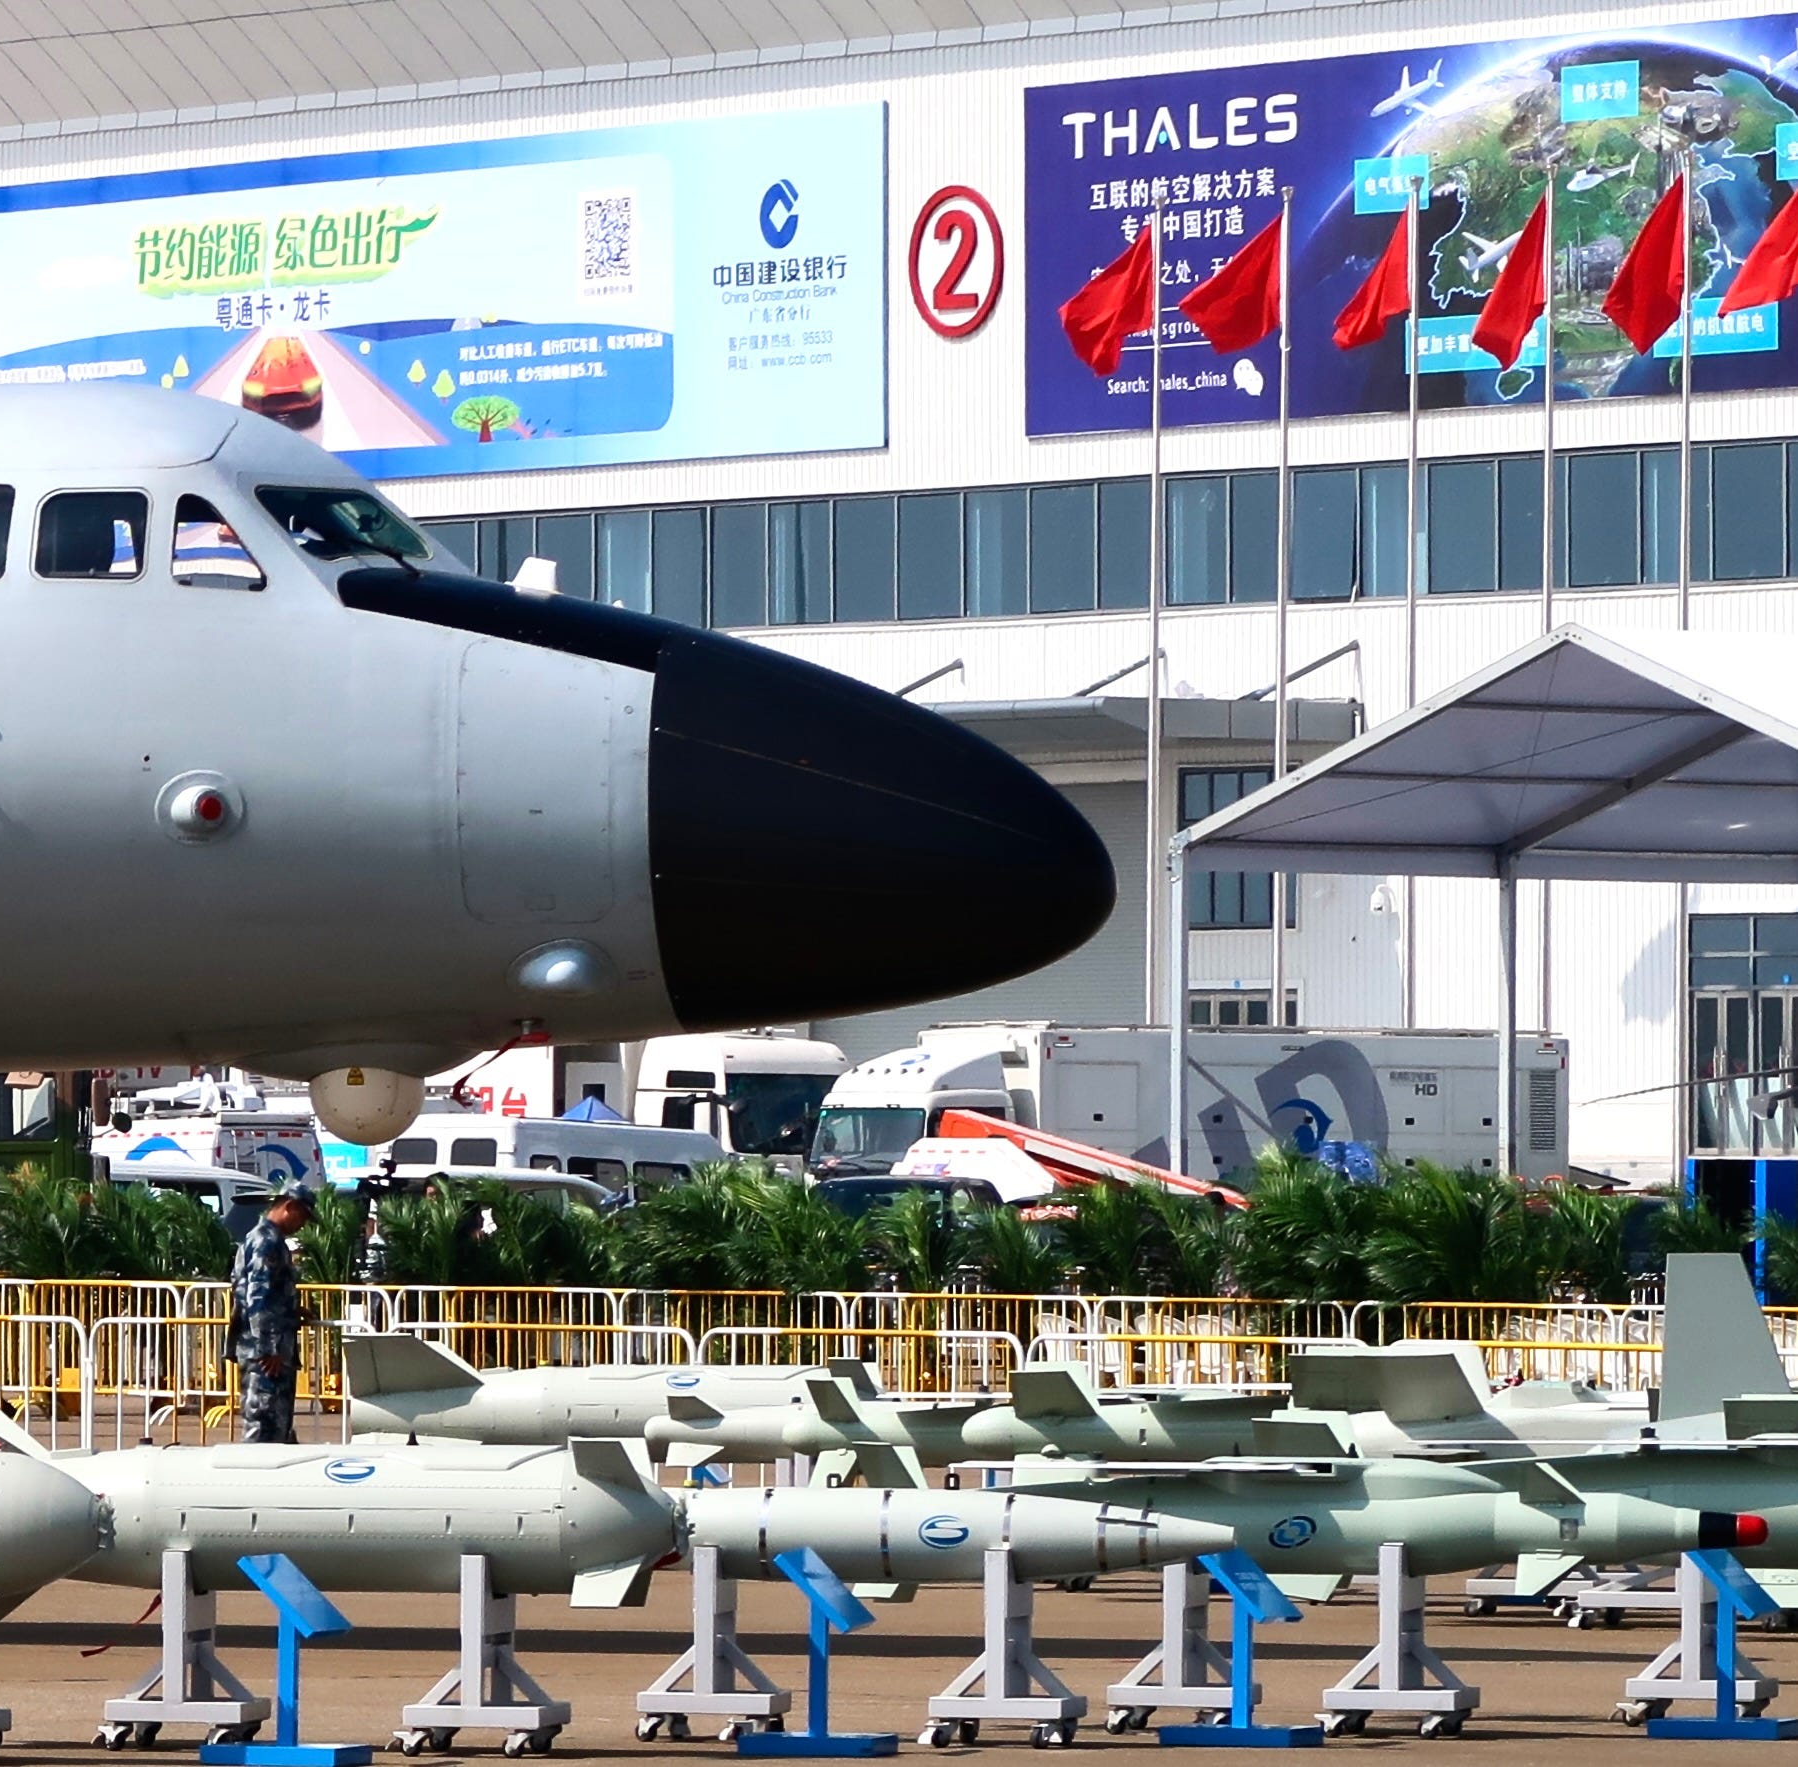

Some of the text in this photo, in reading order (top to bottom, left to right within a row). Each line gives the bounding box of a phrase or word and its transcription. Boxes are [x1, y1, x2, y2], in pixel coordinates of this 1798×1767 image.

[1062, 93, 1298, 159] THALES
[135, 200, 439, 284] 节约能源 绿色出行
[713, 254, 847, 288] 中国建设银行
[933, 209, 979, 310] 2
[722, 284, 837, 305] China Construction Bank
[1107, 370, 1228, 396] Search: hales_china
[1414, 1083, 1438, 1096] HD
